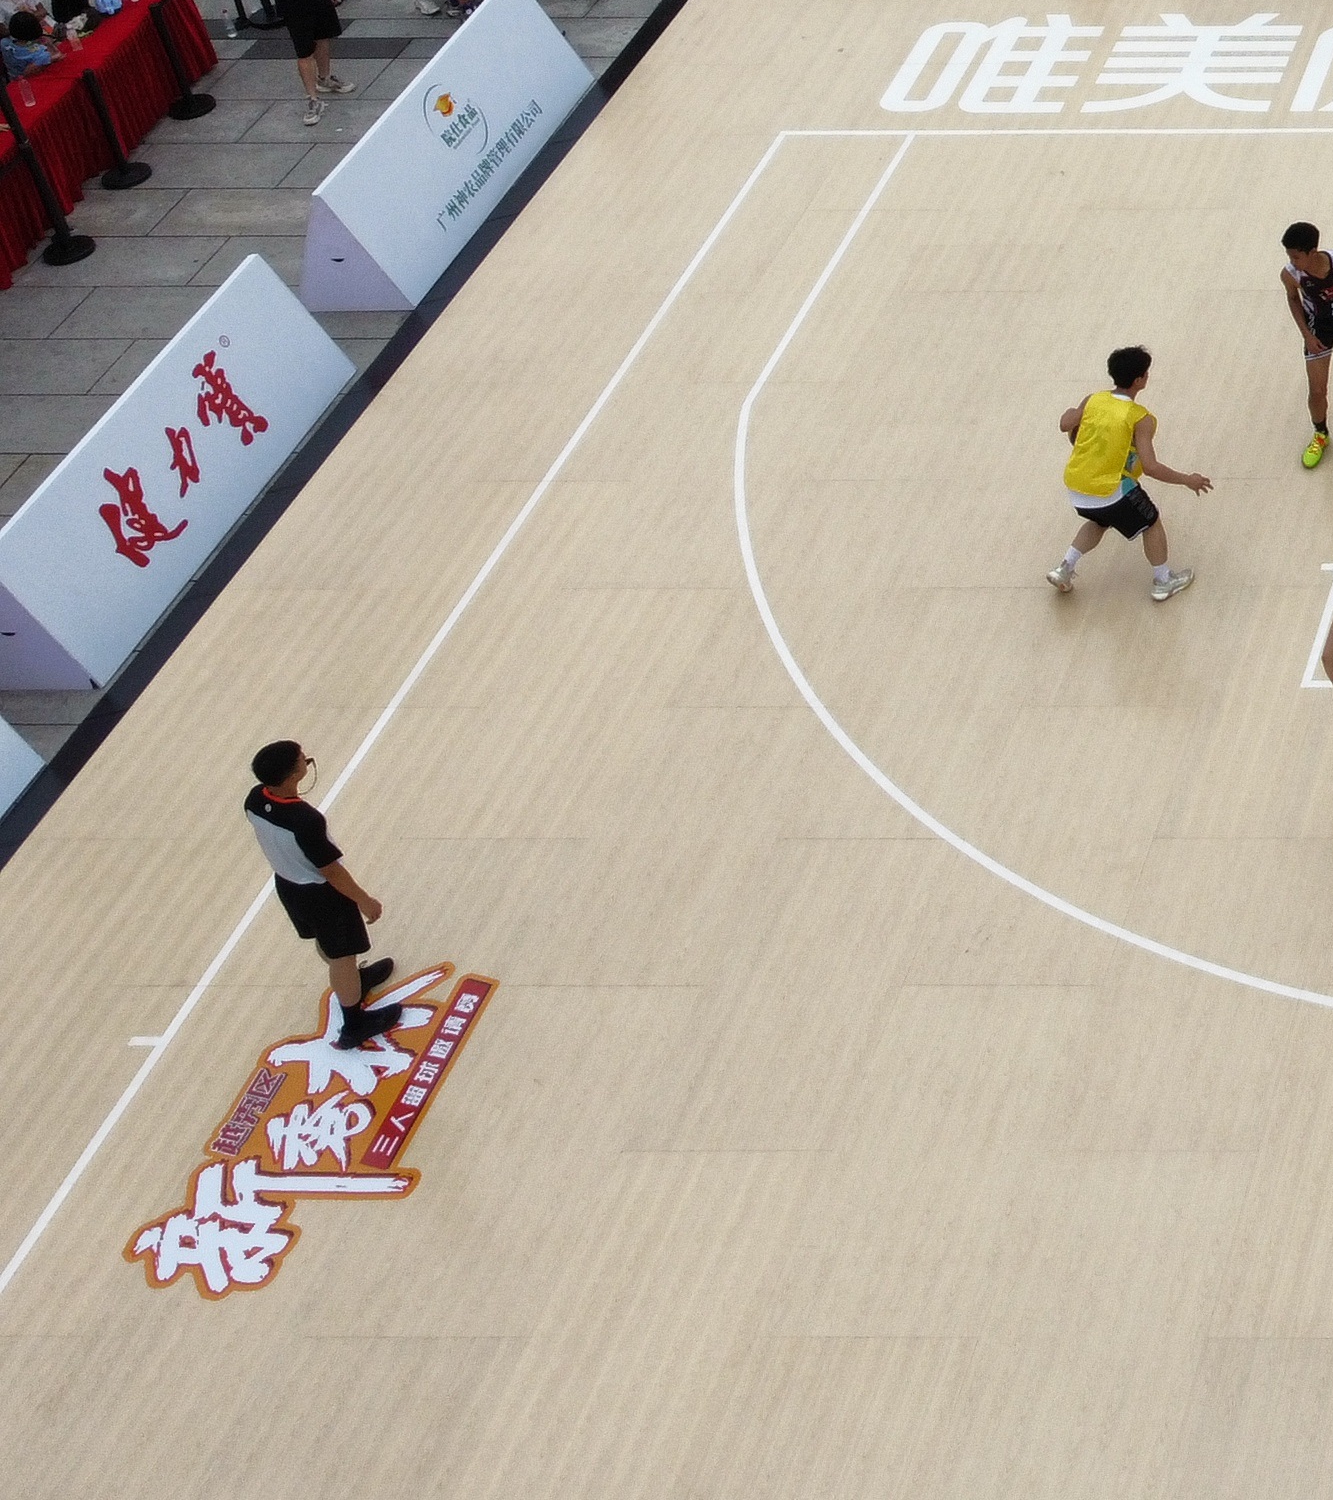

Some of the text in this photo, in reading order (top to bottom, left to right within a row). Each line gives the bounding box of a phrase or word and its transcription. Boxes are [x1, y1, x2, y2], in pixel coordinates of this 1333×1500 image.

[436, 99, 543, 232] 广州神农品牌管理有限公司
[440, 103, 479, 148] 院仕食品
[131, 967, 449, 1293] 新秀杯
[211, 1068, 287, 1156] 越秀区
